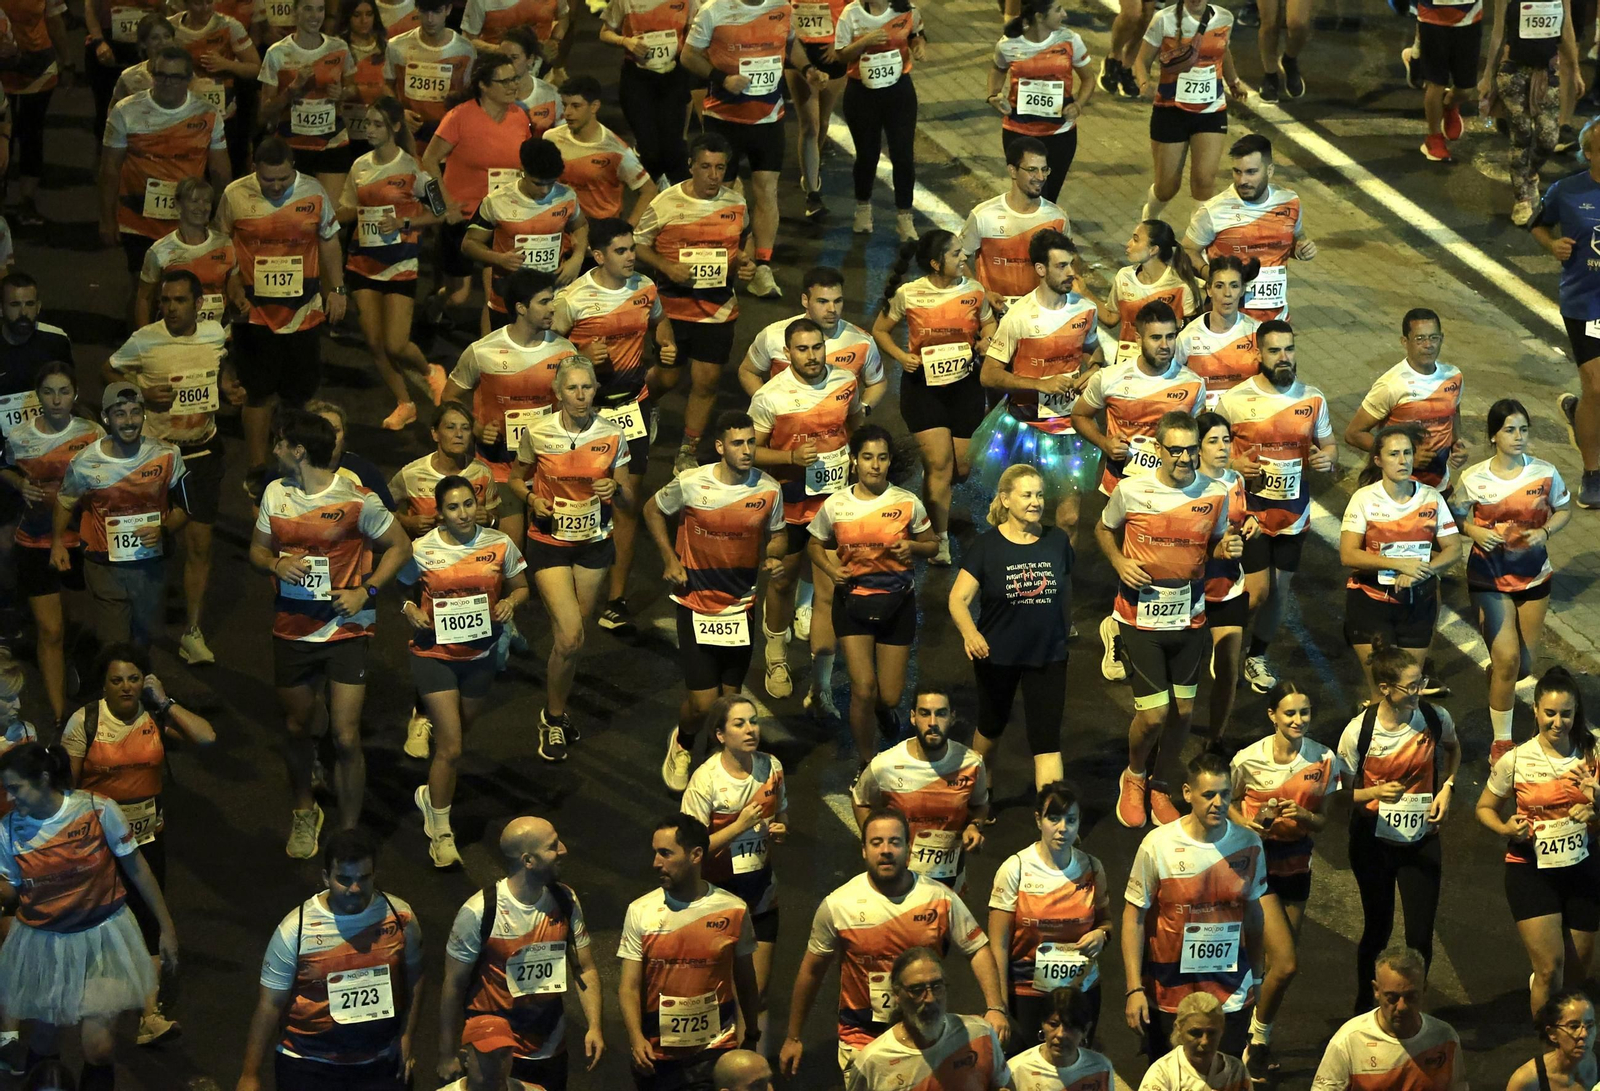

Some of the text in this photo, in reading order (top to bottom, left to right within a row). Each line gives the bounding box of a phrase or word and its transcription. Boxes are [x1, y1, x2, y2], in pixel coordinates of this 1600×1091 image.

[798, 16, 823, 28] 3217
[1525, 17, 1557, 28] 15927
[749, 72, 775, 84] 7730
[867, 66, 894, 79] 2934
[409, 76, 445, 91] 23815
[1184, 82, 1210, 93] 2736
[1026, 94, 1053, 107] 2656
[296, 112, 330, 125] 14257
[692, 264, 721, 277] 1534
[264, 273, 293, 286] 1137
[1251, 284, 1282, 298] 14567
[633, 295, 650, 306] KH7
[960, 297, 977, 306] KH7
[1072, 319, 1087, 329] KH7
[835, 352, 855, 364] KH7
[930, 359, 966, 374] 15272
[180, 386, 210, 402] 8604
[1167, 389, 1188, 401] KH7
[1295, 405, 1313, 417] KH7
[591, 443, 611, 454] KH7
[142, 464, 163, 478] KH7
[815, 467, 844, 482] 9802
[1526, 485, 1544, 495] KH7
[746, 498, 766, 510] KH7
[1191, 503, 1212, 514] KH7
[321, 509, 345, 522] KH7
[882, 509, 902, 520] KH7
[1419, 509, 1436, 519] KH7
[558, 515, 596, 530] 12375
[1137, 534, 1151, 542] 37
[476, 552, 496, 563] KH7
[1144, 603, 1184, 616] 18277
[441, 613, 484, 631] 18025
[699, 623, 740, 635] 24857
[1386, 812, 1424, 829] 19161
[1539, 834, 1583, 855] 24753
[913, 909, 937, 923] KH7
[706, 917, 729, 930] KH7
[1189, 943, 1232, 959] 16967
[517, 963, 553, 981] 2730
[1042, 963, 1085, 979] 16965
[341, 988, 379, 1009] 2723
[671, 1015, 709, 1032] 2725
